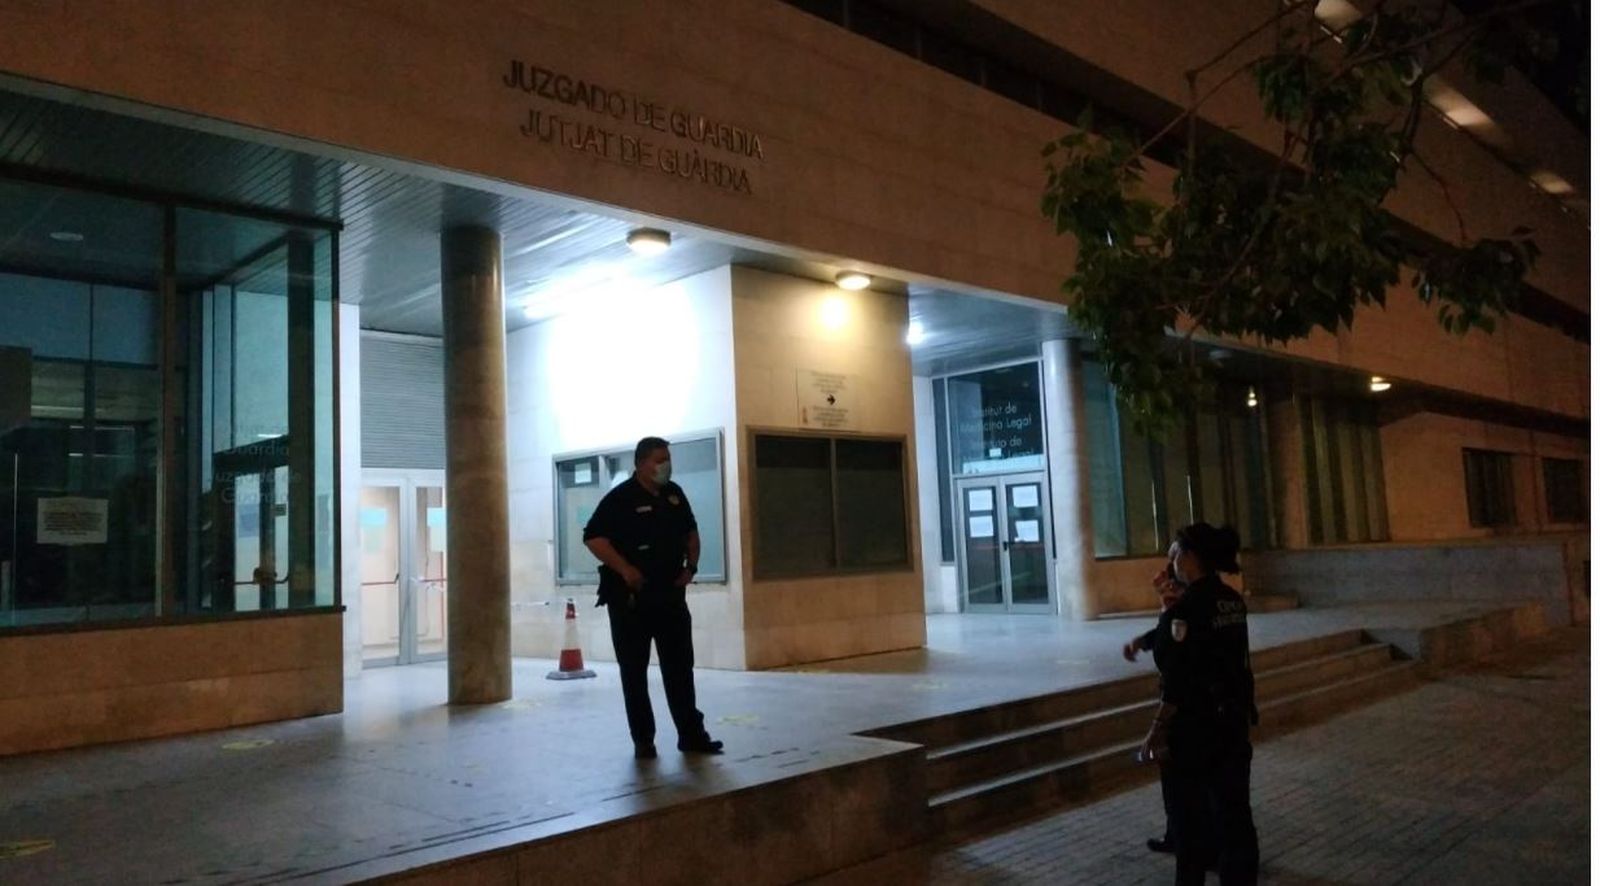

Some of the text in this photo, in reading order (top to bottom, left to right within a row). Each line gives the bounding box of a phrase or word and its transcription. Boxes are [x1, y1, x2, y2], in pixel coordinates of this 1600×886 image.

[503, 59, 764, 160] JUZGADO DE GUARDIA
[519, 108, 753, 196] JUTJAT DE GUÀRDIA
[970, 400, 1017, 418] titut de
[1006, 412, 1032, 430] Legal
[1009, 434, 1023, 447] de
